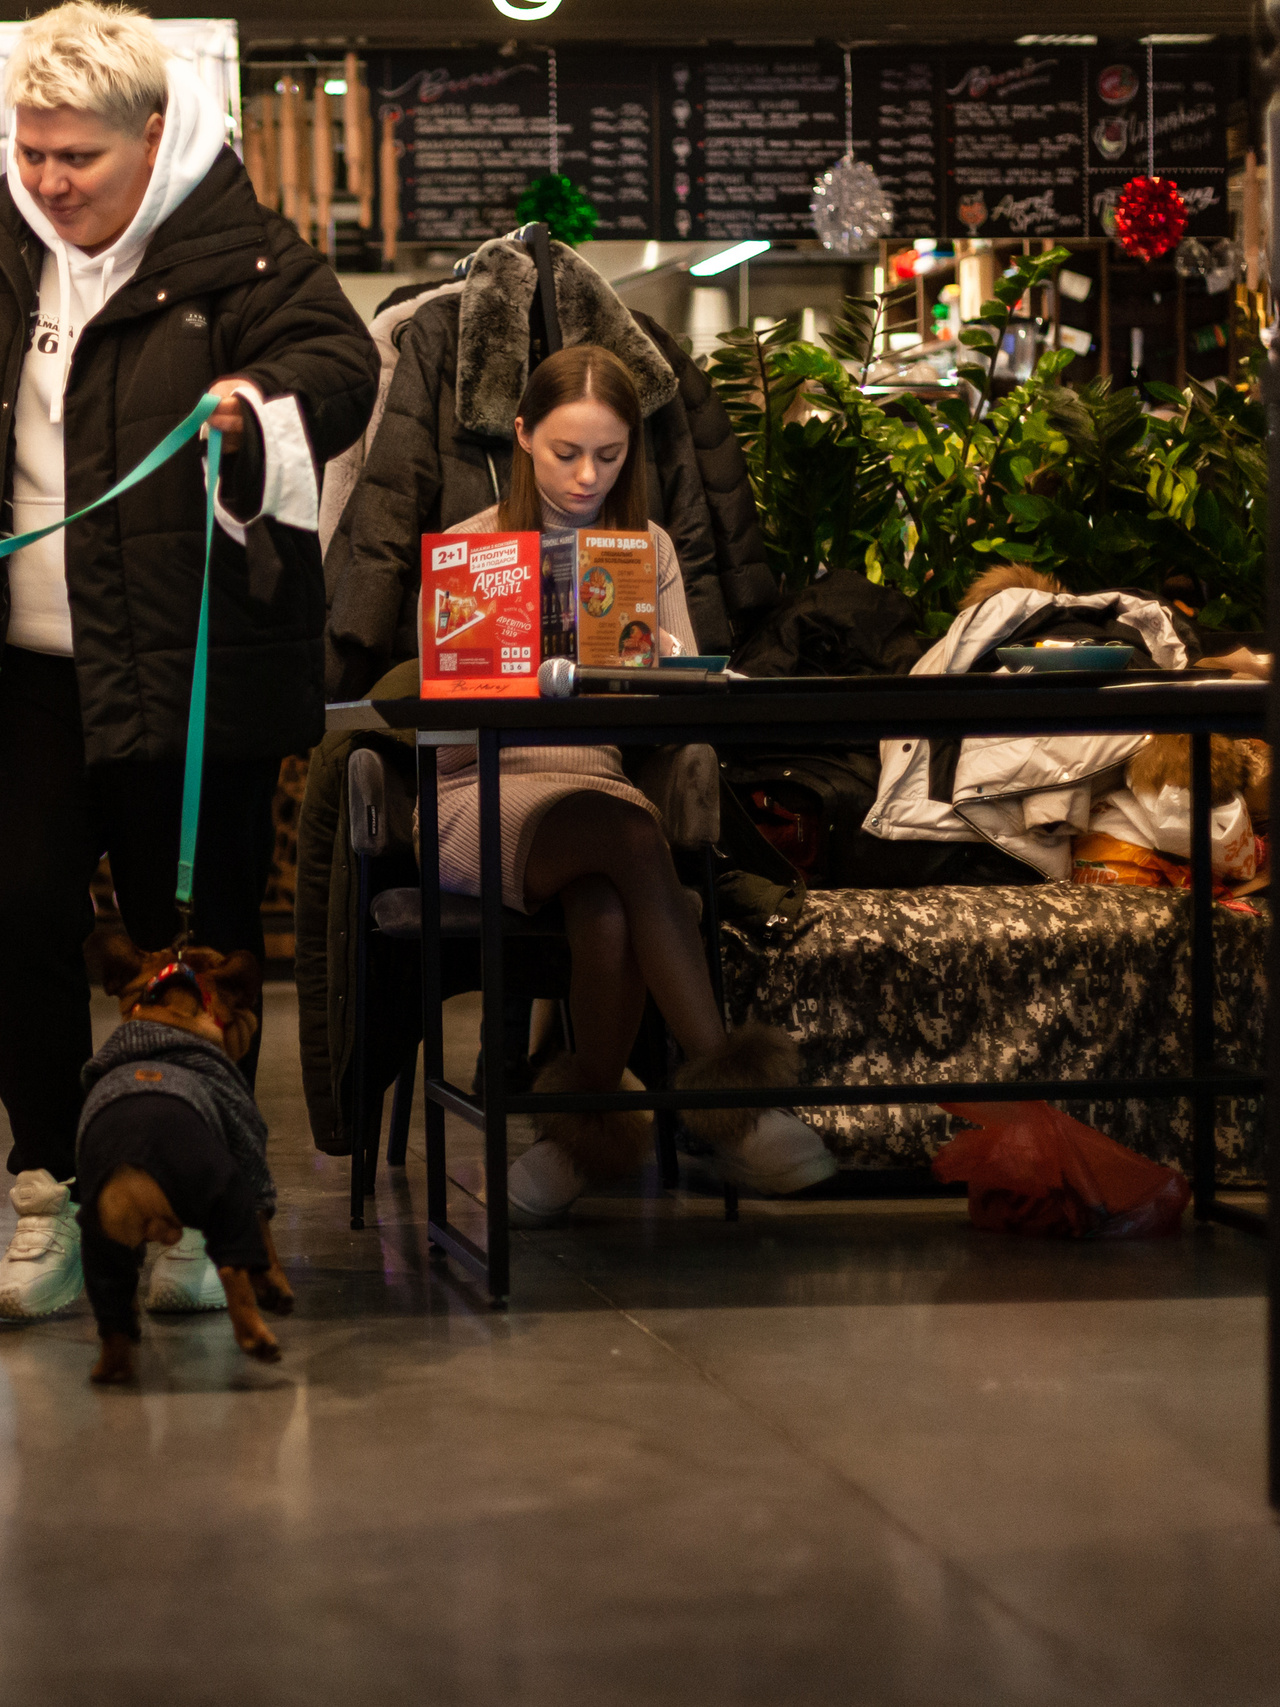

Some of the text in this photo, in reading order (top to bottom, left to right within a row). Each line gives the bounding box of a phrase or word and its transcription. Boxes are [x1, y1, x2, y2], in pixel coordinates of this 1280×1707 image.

[586, 536, 615, 548] ГРЕКИ
[617, 537, 648, 550] ЗДЕСЬ
[438, 547, 463, 565] 2+1
[472, 548, 516, 563] И ПОЛУЧИ
[486, 556, 515, 567] ПОДАРОК
[472, 566, 531, 592] APEROL
[496, 615, 532, 631] APERITIVO
[501, 629, 518, 638] 1919
